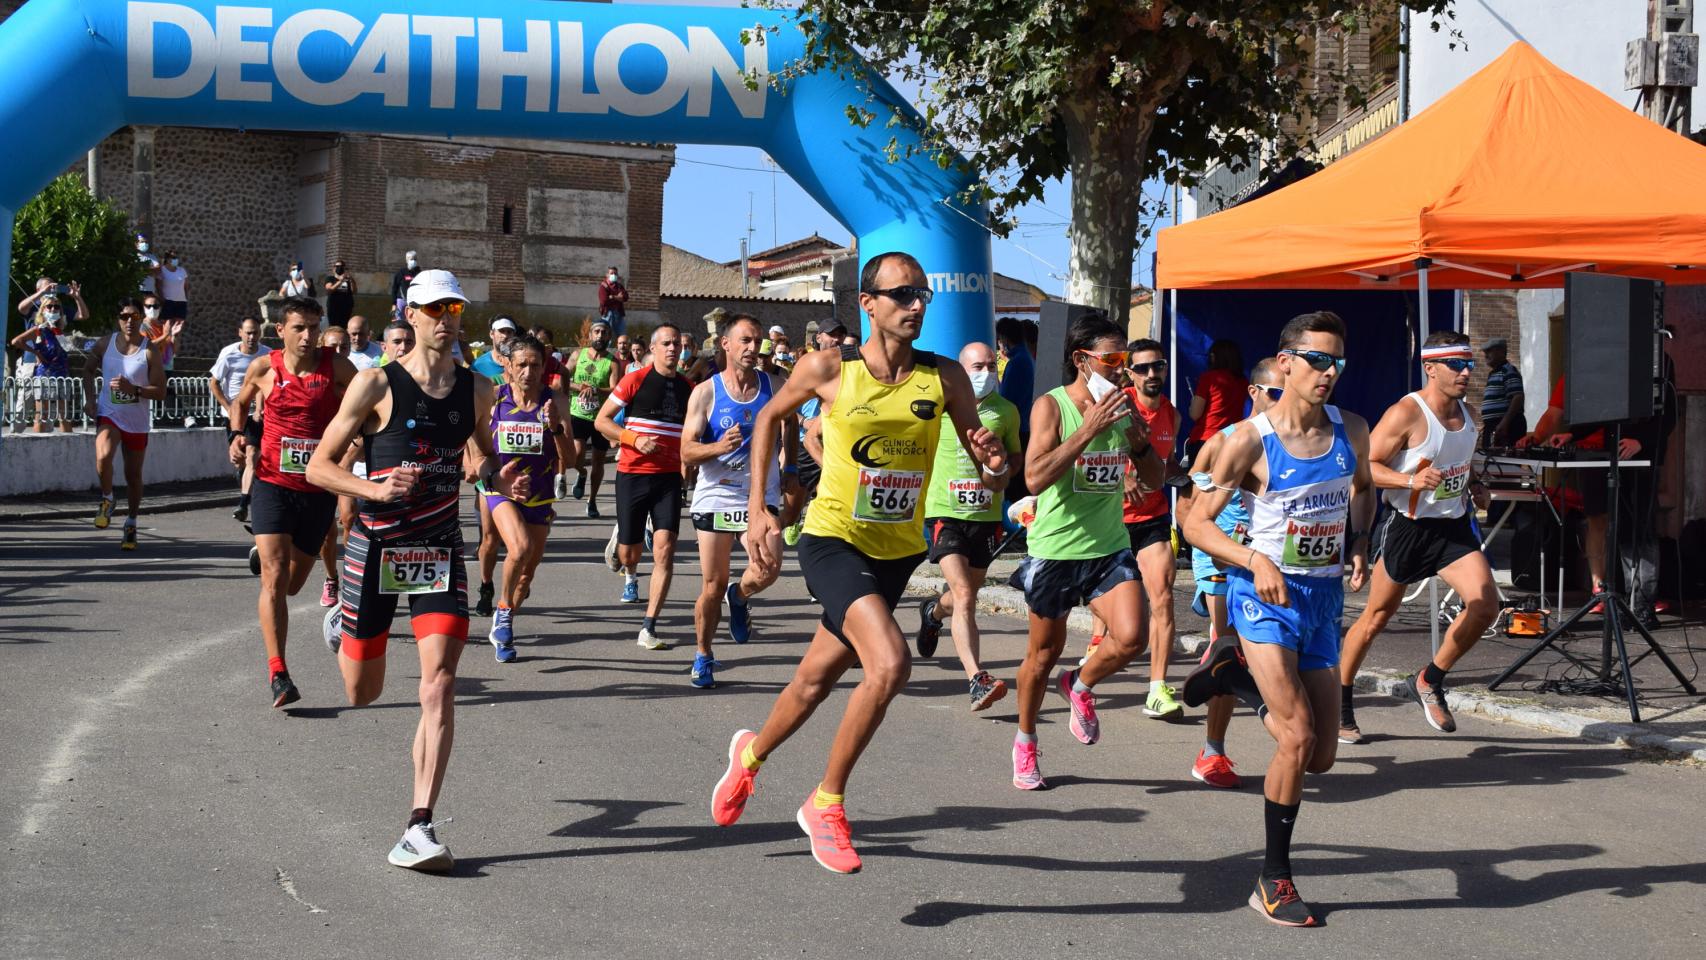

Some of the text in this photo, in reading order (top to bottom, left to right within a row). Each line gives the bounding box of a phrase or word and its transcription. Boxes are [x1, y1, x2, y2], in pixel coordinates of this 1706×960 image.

[127, 1, 769, 119] DECATHLON
[500, 424, 542, 433] bedunia
[283, 440, 320, 450] bedun
[506, 433, 532, 446] 501
[882, 438, 917, 447] CLÍNICA
[291, 451, 311, 464] 50
[401, 460, 457, 474] RODRIGUEZ
[860, 470, 924, 489] bedunia
[1085, 466, 1120, 483] 524
[949, 481, 985, 491] bedun
[870, 488, 910, 511] 566
[958, 490, 985, 504] 536
[1283, 499, 1298, 512] LA
[1287, 520, 1345, 538] bedunia
[1296, 536, 1336, 557] 565
[393, 562, 436, 582] 575
